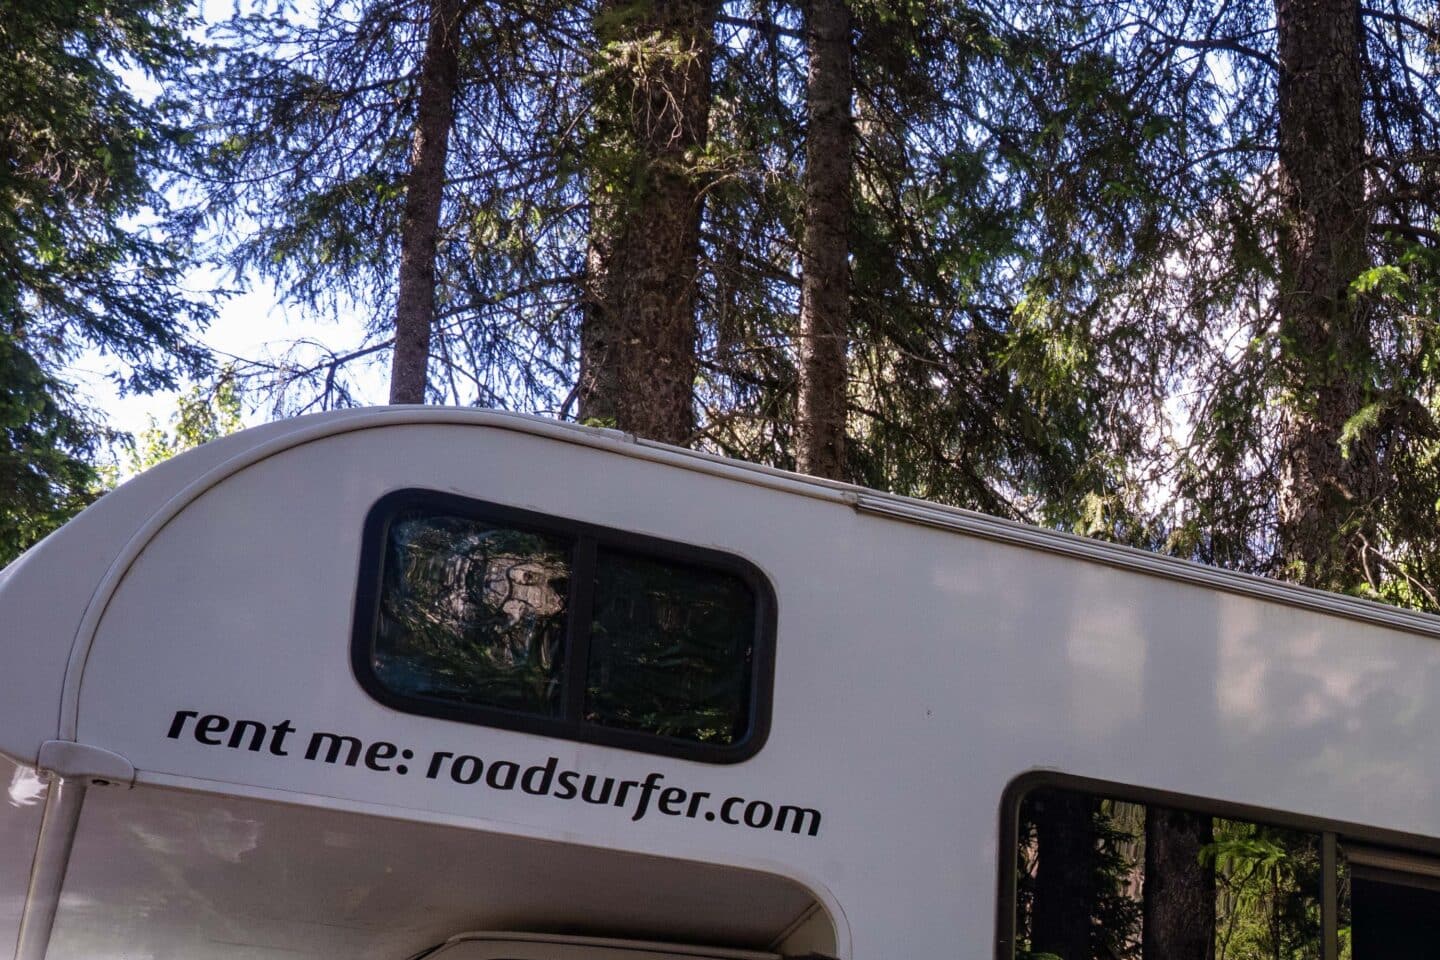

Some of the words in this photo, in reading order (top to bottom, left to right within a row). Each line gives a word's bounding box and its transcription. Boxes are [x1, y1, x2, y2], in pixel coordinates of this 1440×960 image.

[167, 709, 297, 757] rent
[303, 731, 415, 776] me:
[425, 750, 823, 838] roadsurfer.com
